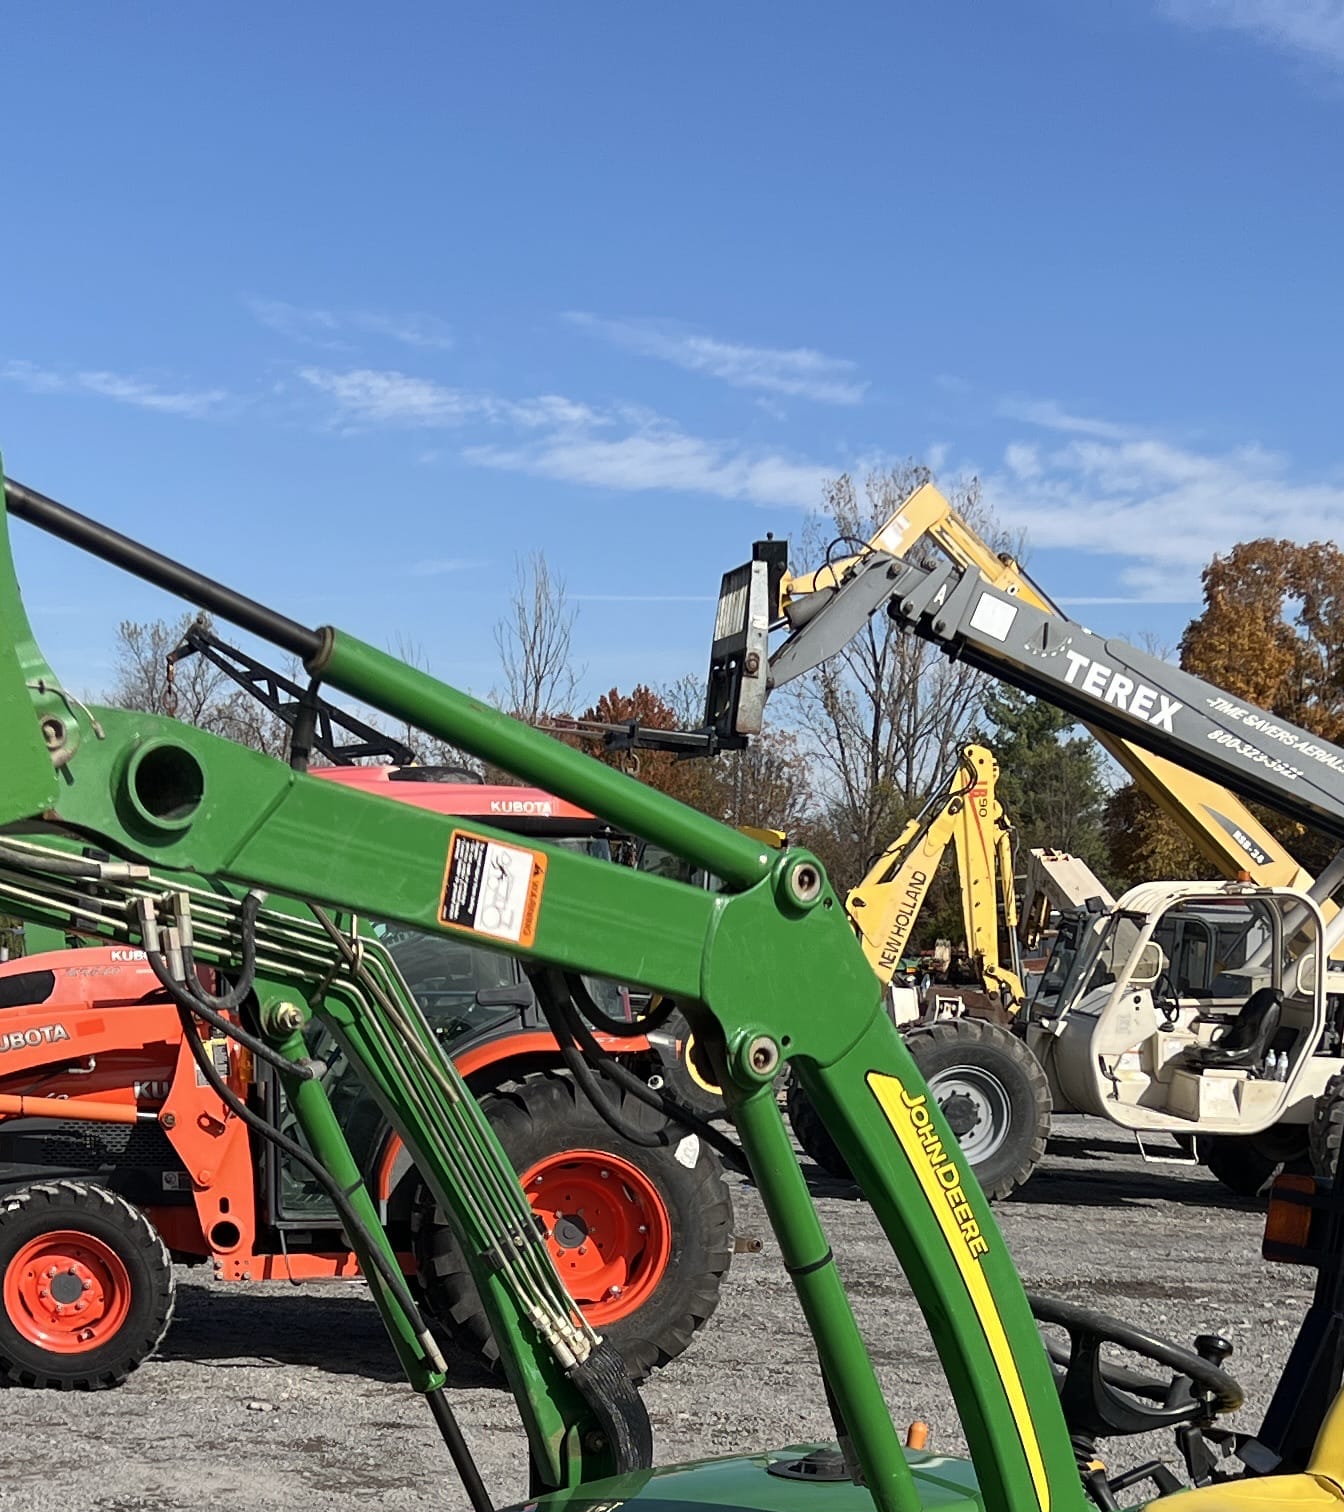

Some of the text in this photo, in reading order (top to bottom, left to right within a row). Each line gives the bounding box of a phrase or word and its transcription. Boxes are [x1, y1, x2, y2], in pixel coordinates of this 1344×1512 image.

[933, 583, 947, 606] A
[1063, 649, 1183, 733] TEREX
[1242, 710, 1299, 747] SAVERS
[490, 800, 553, 813] KUBOTA
[878, 870, 927, 970] NEW HOLLAND
[111, 950, 149, 962] KUB
[901, 1089, 990, 1259] JOHN DEERE
